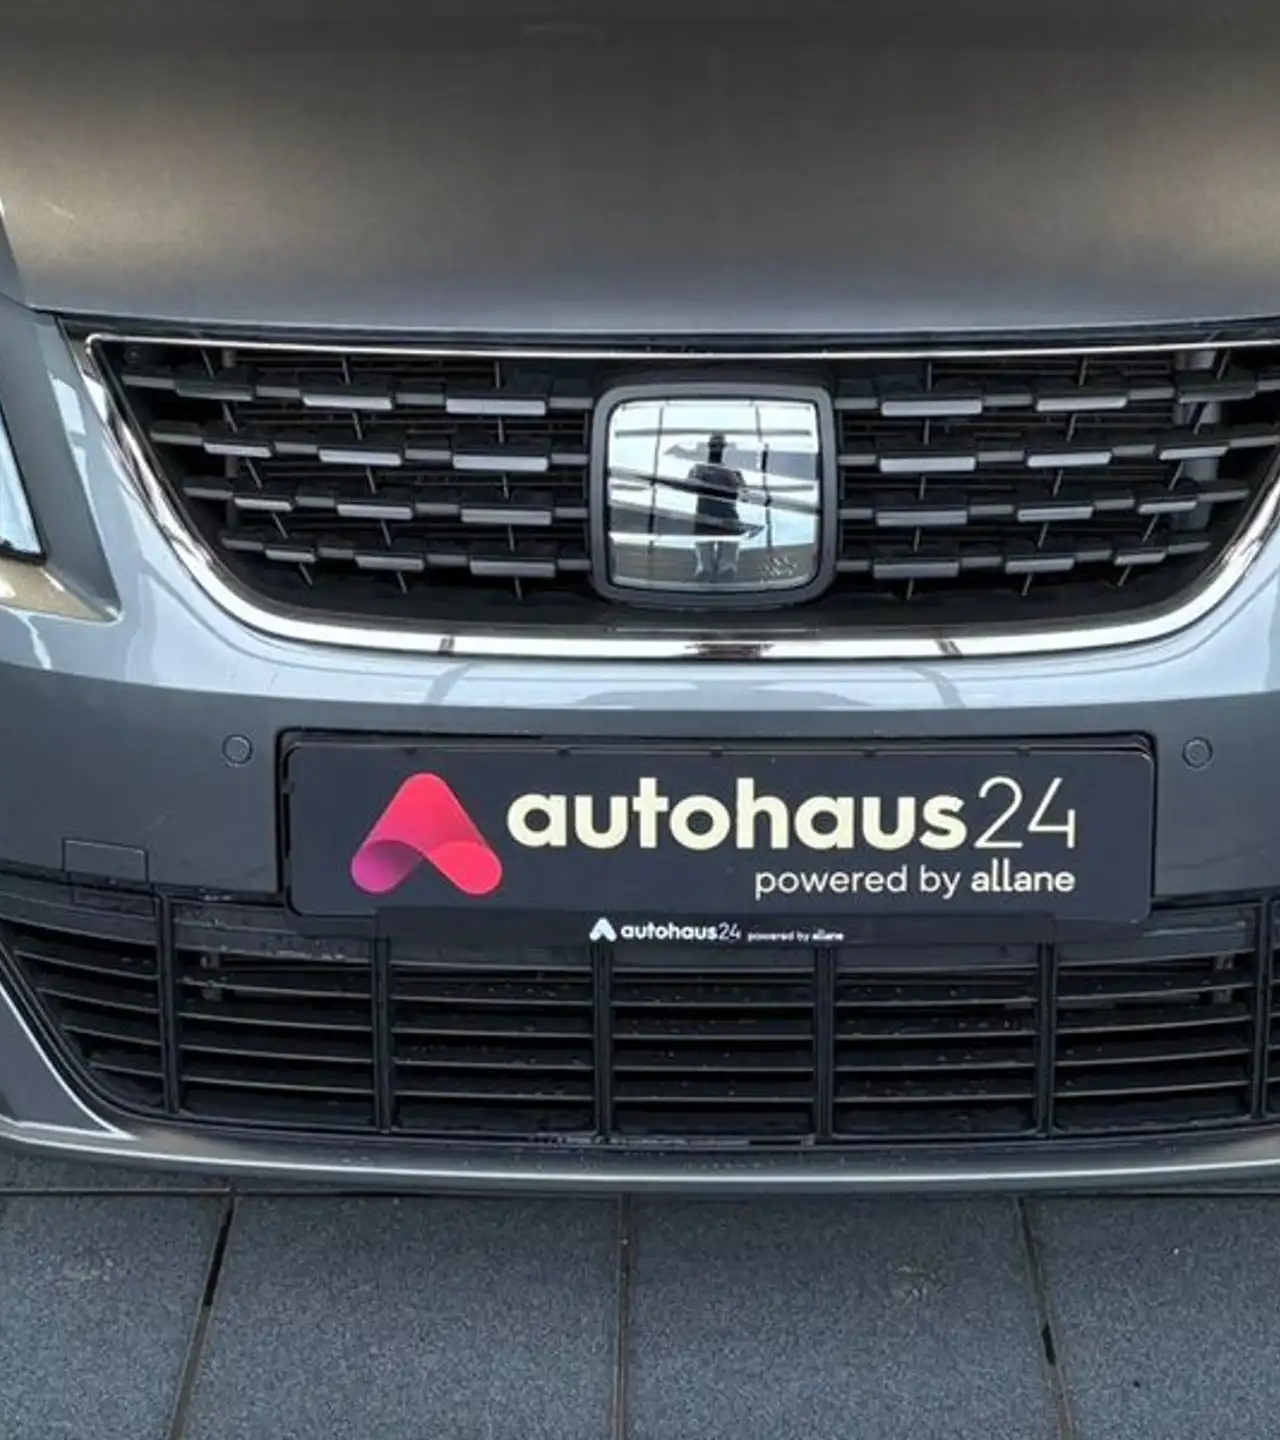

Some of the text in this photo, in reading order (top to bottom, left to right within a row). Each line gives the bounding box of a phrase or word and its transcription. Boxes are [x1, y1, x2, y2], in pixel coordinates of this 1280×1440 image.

[506, 775, 1076, 851] autohaus24
[755, 858, 1076, 901] powered by allane
[620, 921, 742, 943] autohaus24
